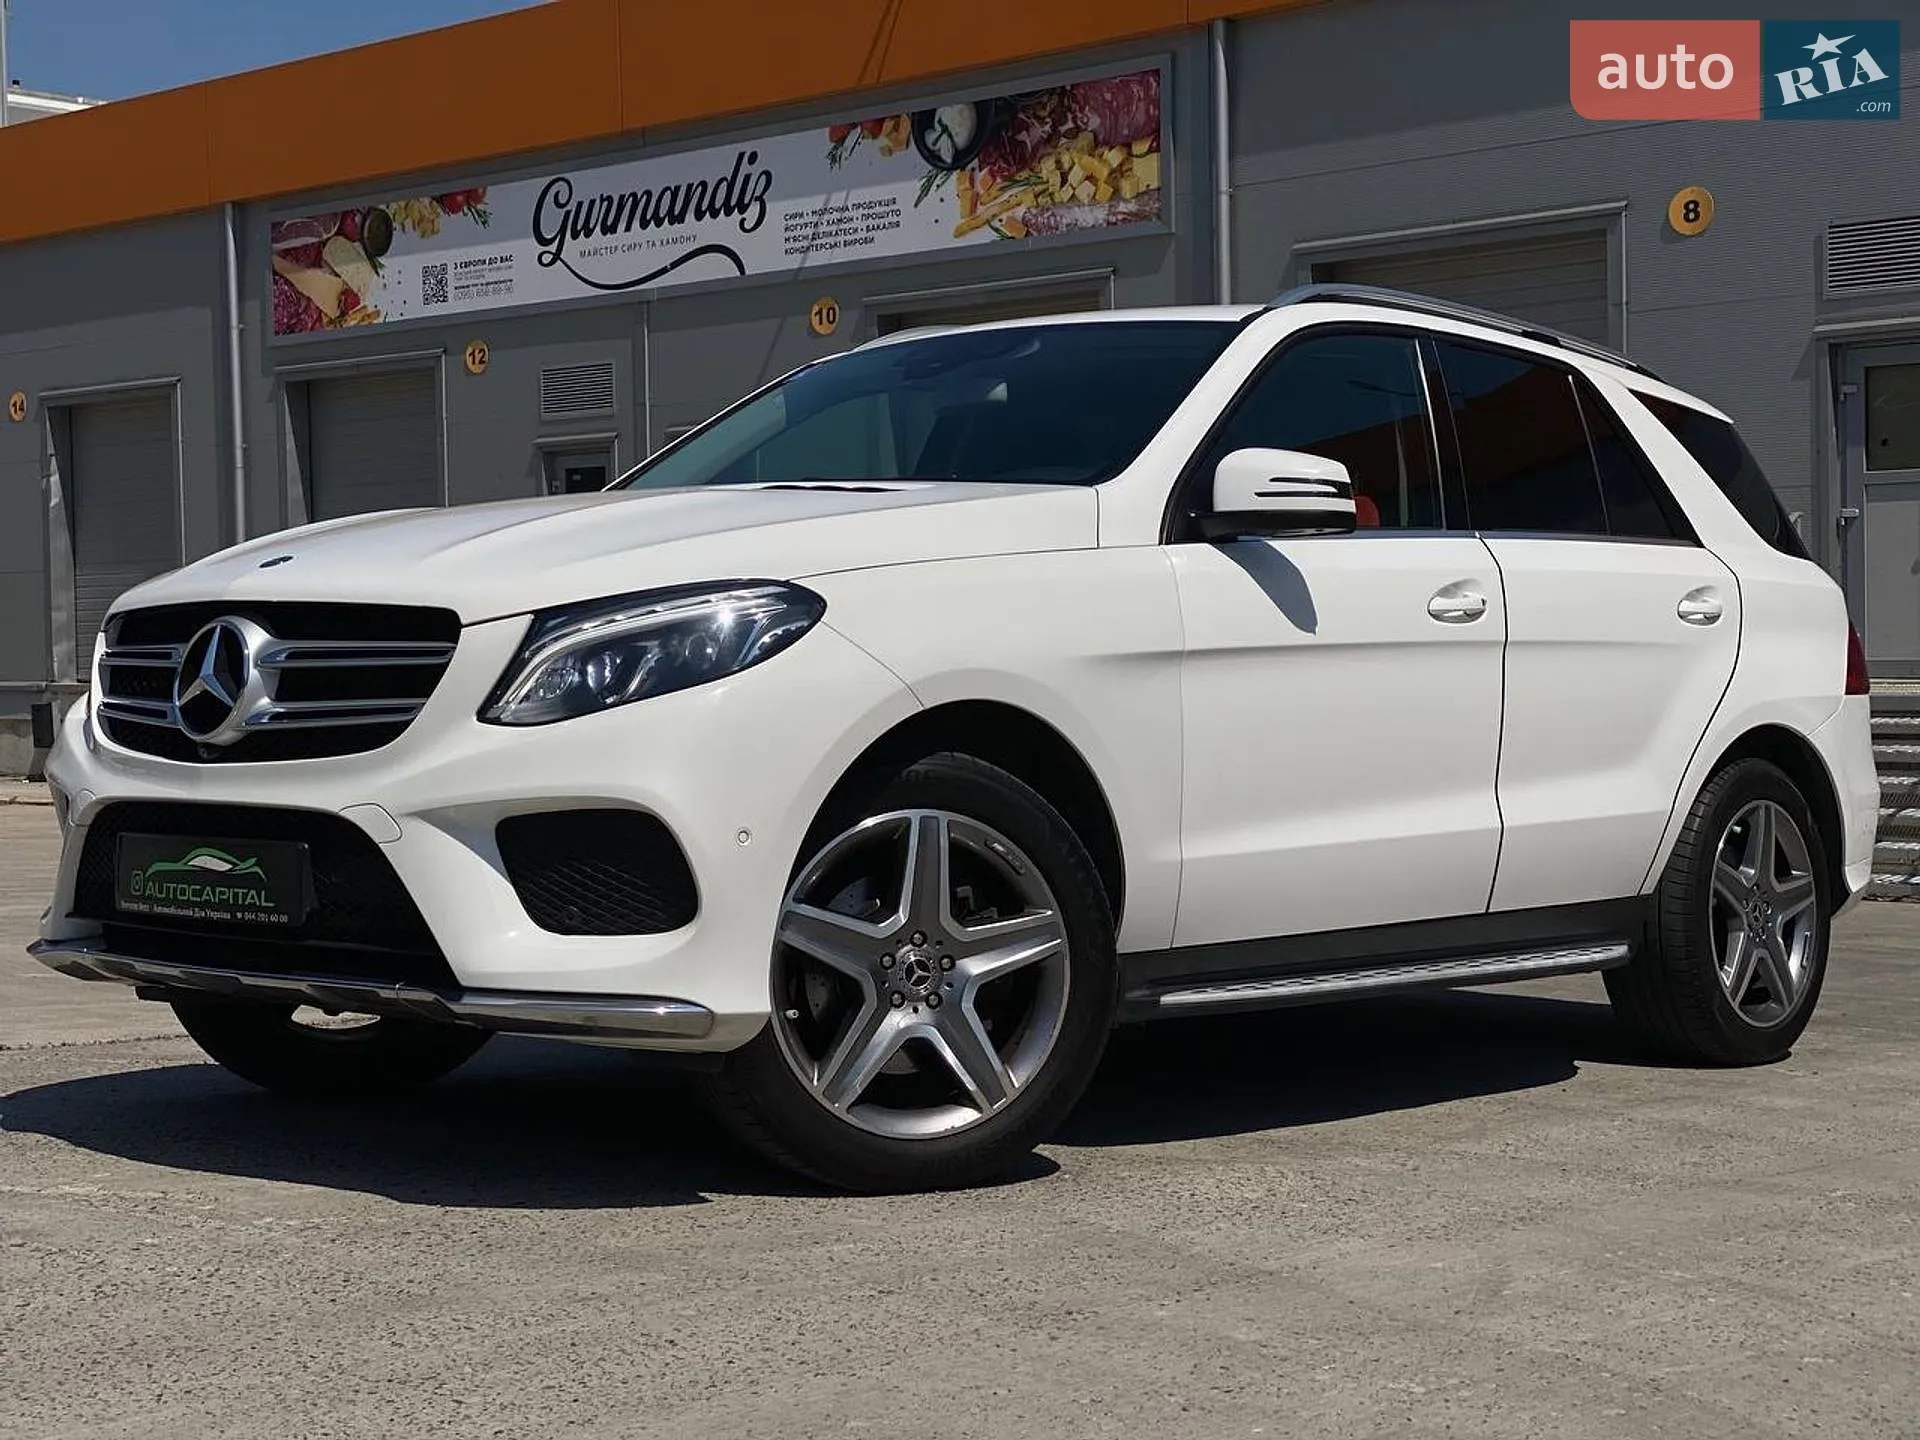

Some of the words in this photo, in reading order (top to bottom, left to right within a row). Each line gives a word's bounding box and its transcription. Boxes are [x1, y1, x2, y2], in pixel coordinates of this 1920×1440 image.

[533, 150, 774, 270] Gurmandiz
[784, 212, 803, 221] СИРИ
[811, 204, 850, 217] МОЛОЧНА
[861, 208, 902, 221] ПРОШУТО
[1682, 199, 1701, 223] 8
[579, 245, 618, 258] МАЙСТЕР
[621, 242, 643, 253] СИРУ
[647, 240, 656, 248] ТА
[660, 234, 697, 246] ХАМОНУ
[843, 235, 875, 249] ВИРОБИ
[488, 256, 498, 267] ДО
[500, 254, 513, 263] ВАС
[814, 306, 836, 325] 10
[469, 348, 486, 365] 12
[12, 399, 24, 415] 14
[145, 881, 276, 908] AUTOCAPITAL
